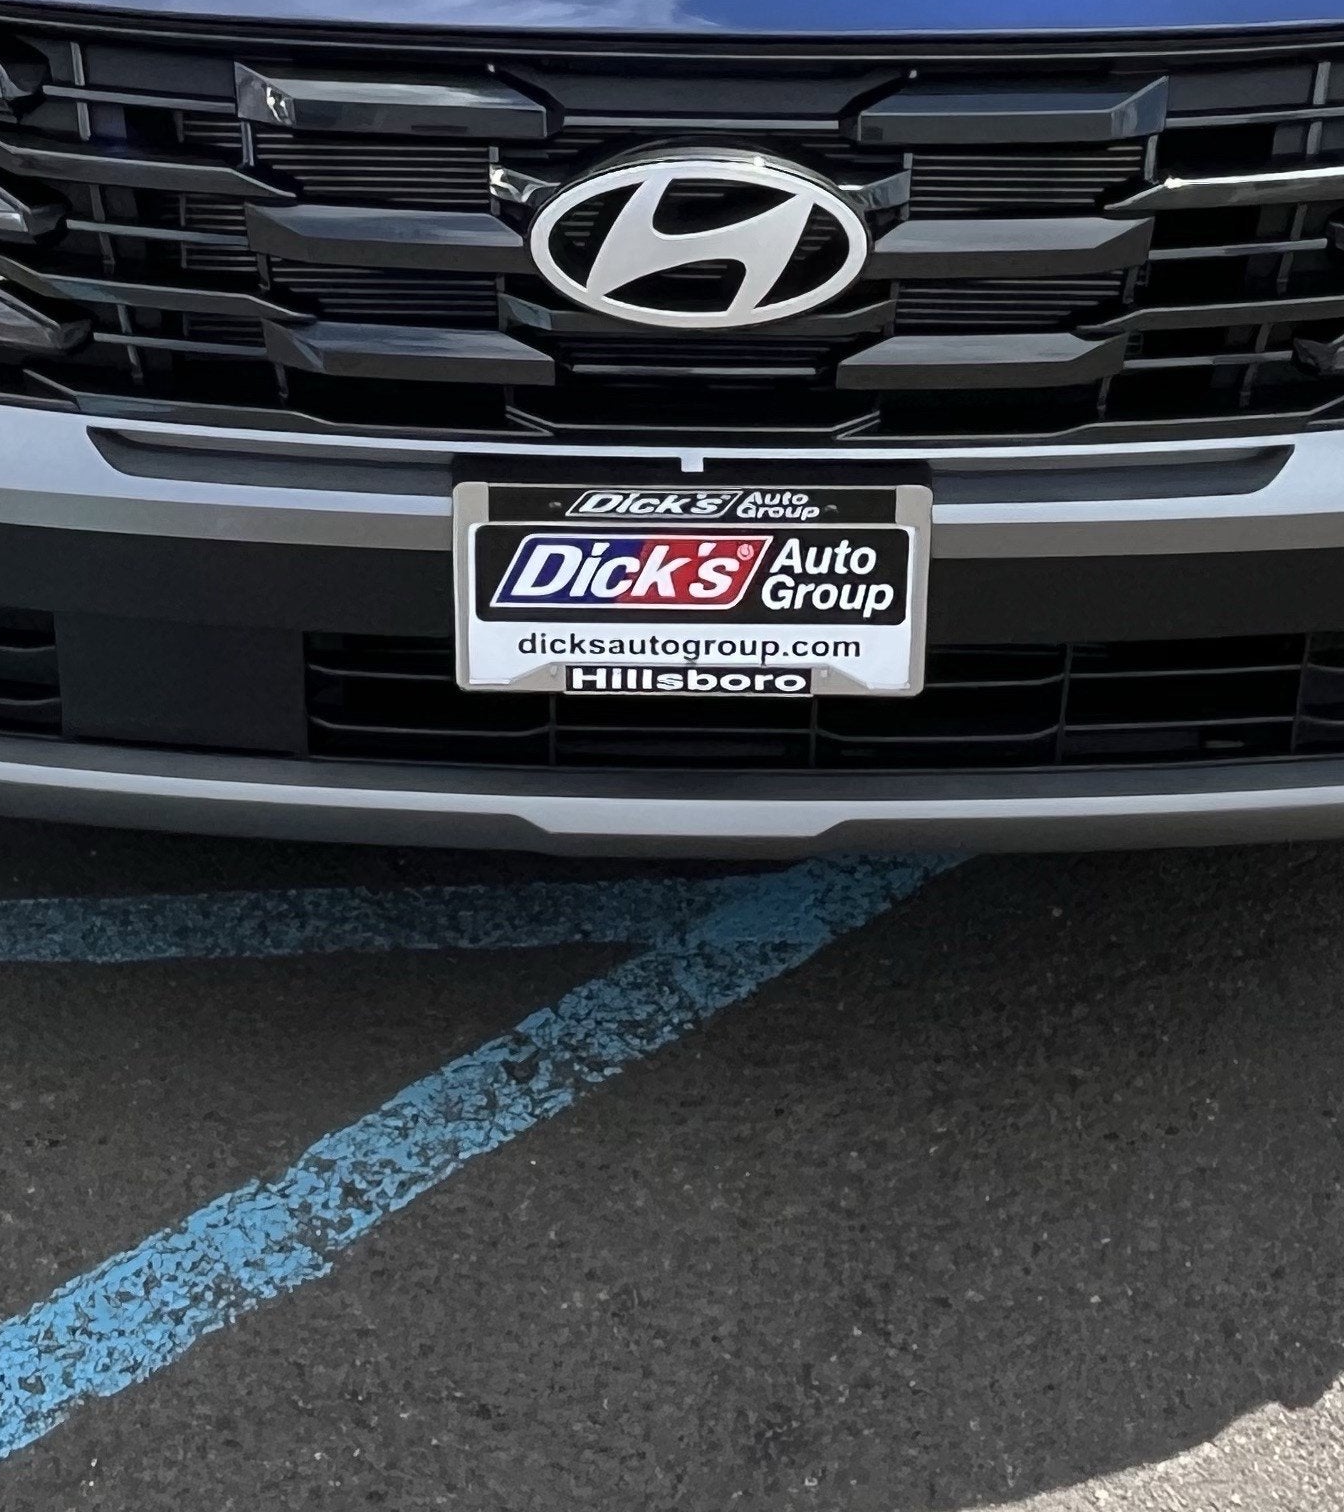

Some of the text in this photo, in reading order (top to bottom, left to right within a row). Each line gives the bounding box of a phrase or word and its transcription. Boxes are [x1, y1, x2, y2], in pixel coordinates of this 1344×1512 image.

[746, 491, 809, 505] Auto
[736, 504, 820, 520] Group
[769, 538, 877, 575] Auto
[761, 576, 894, 617] Group
[517, 633, 861, 662] dicksautogroup.com
[571, 668, 806, 691] Hillsboro
